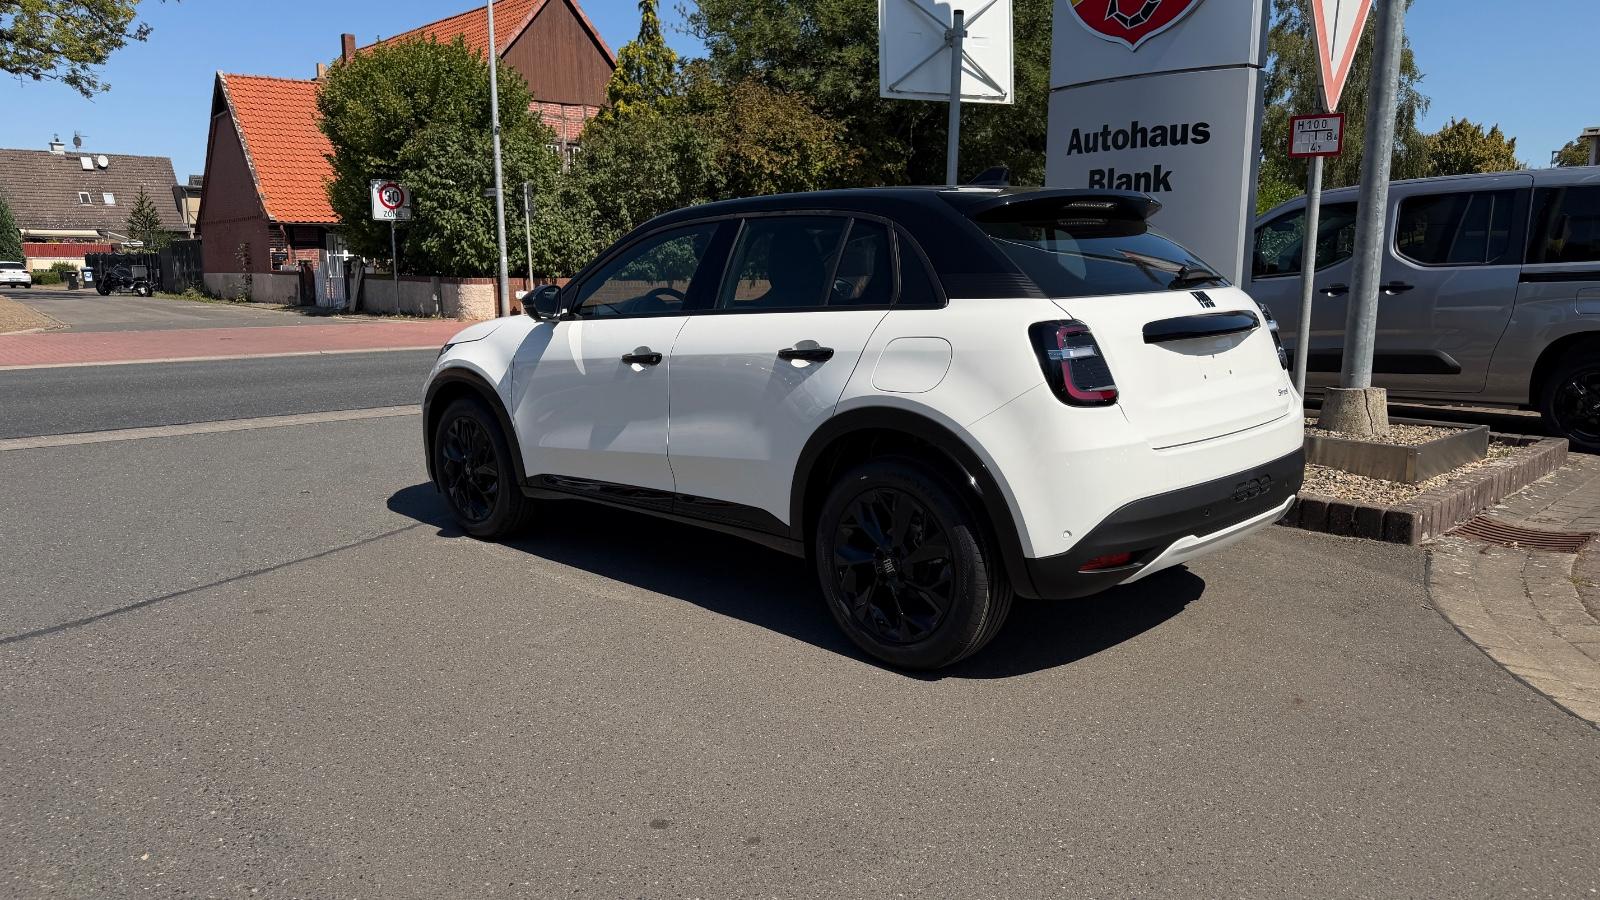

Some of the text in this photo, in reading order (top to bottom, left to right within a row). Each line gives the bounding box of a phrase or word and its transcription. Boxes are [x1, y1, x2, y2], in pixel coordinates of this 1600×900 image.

[1297, 119, 1328, 131] H100
[1066, 120, 1211, 156] Autohaus
[1089, 165, 1172, 192] Blank
[384, 190, 400, 203] 30
